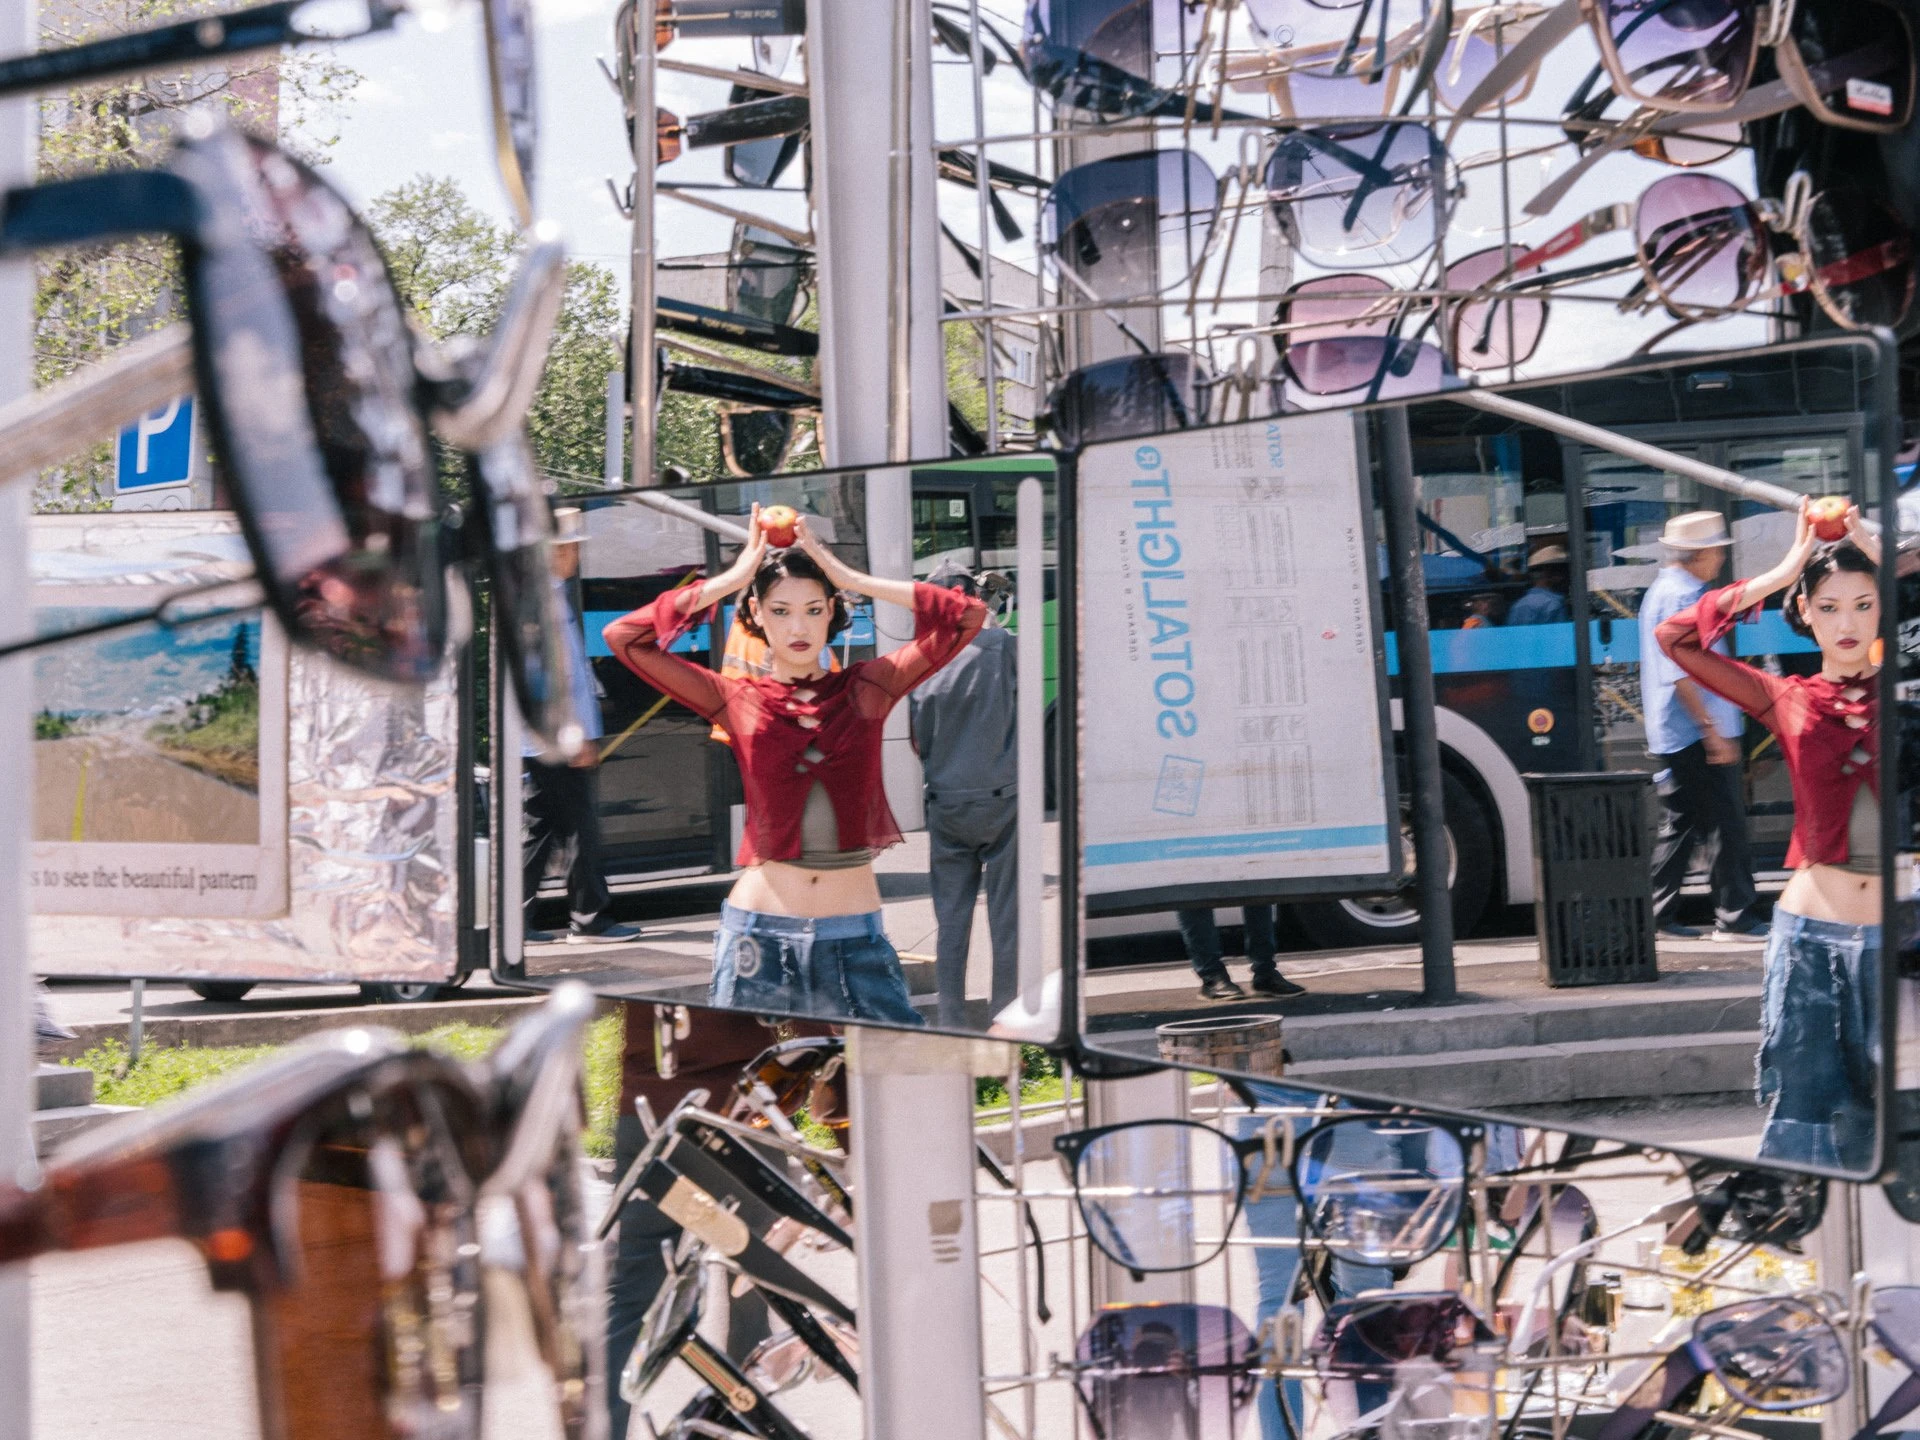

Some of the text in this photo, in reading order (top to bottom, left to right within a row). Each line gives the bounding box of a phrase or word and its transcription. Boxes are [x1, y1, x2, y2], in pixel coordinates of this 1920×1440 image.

[43, 869, 59, 888] to
[63, 871, 89, 888] see
[92, 865, 117, 889] the
[121, 865, 195, 890] beautiful
[198, 870, 258, 896] pattern
